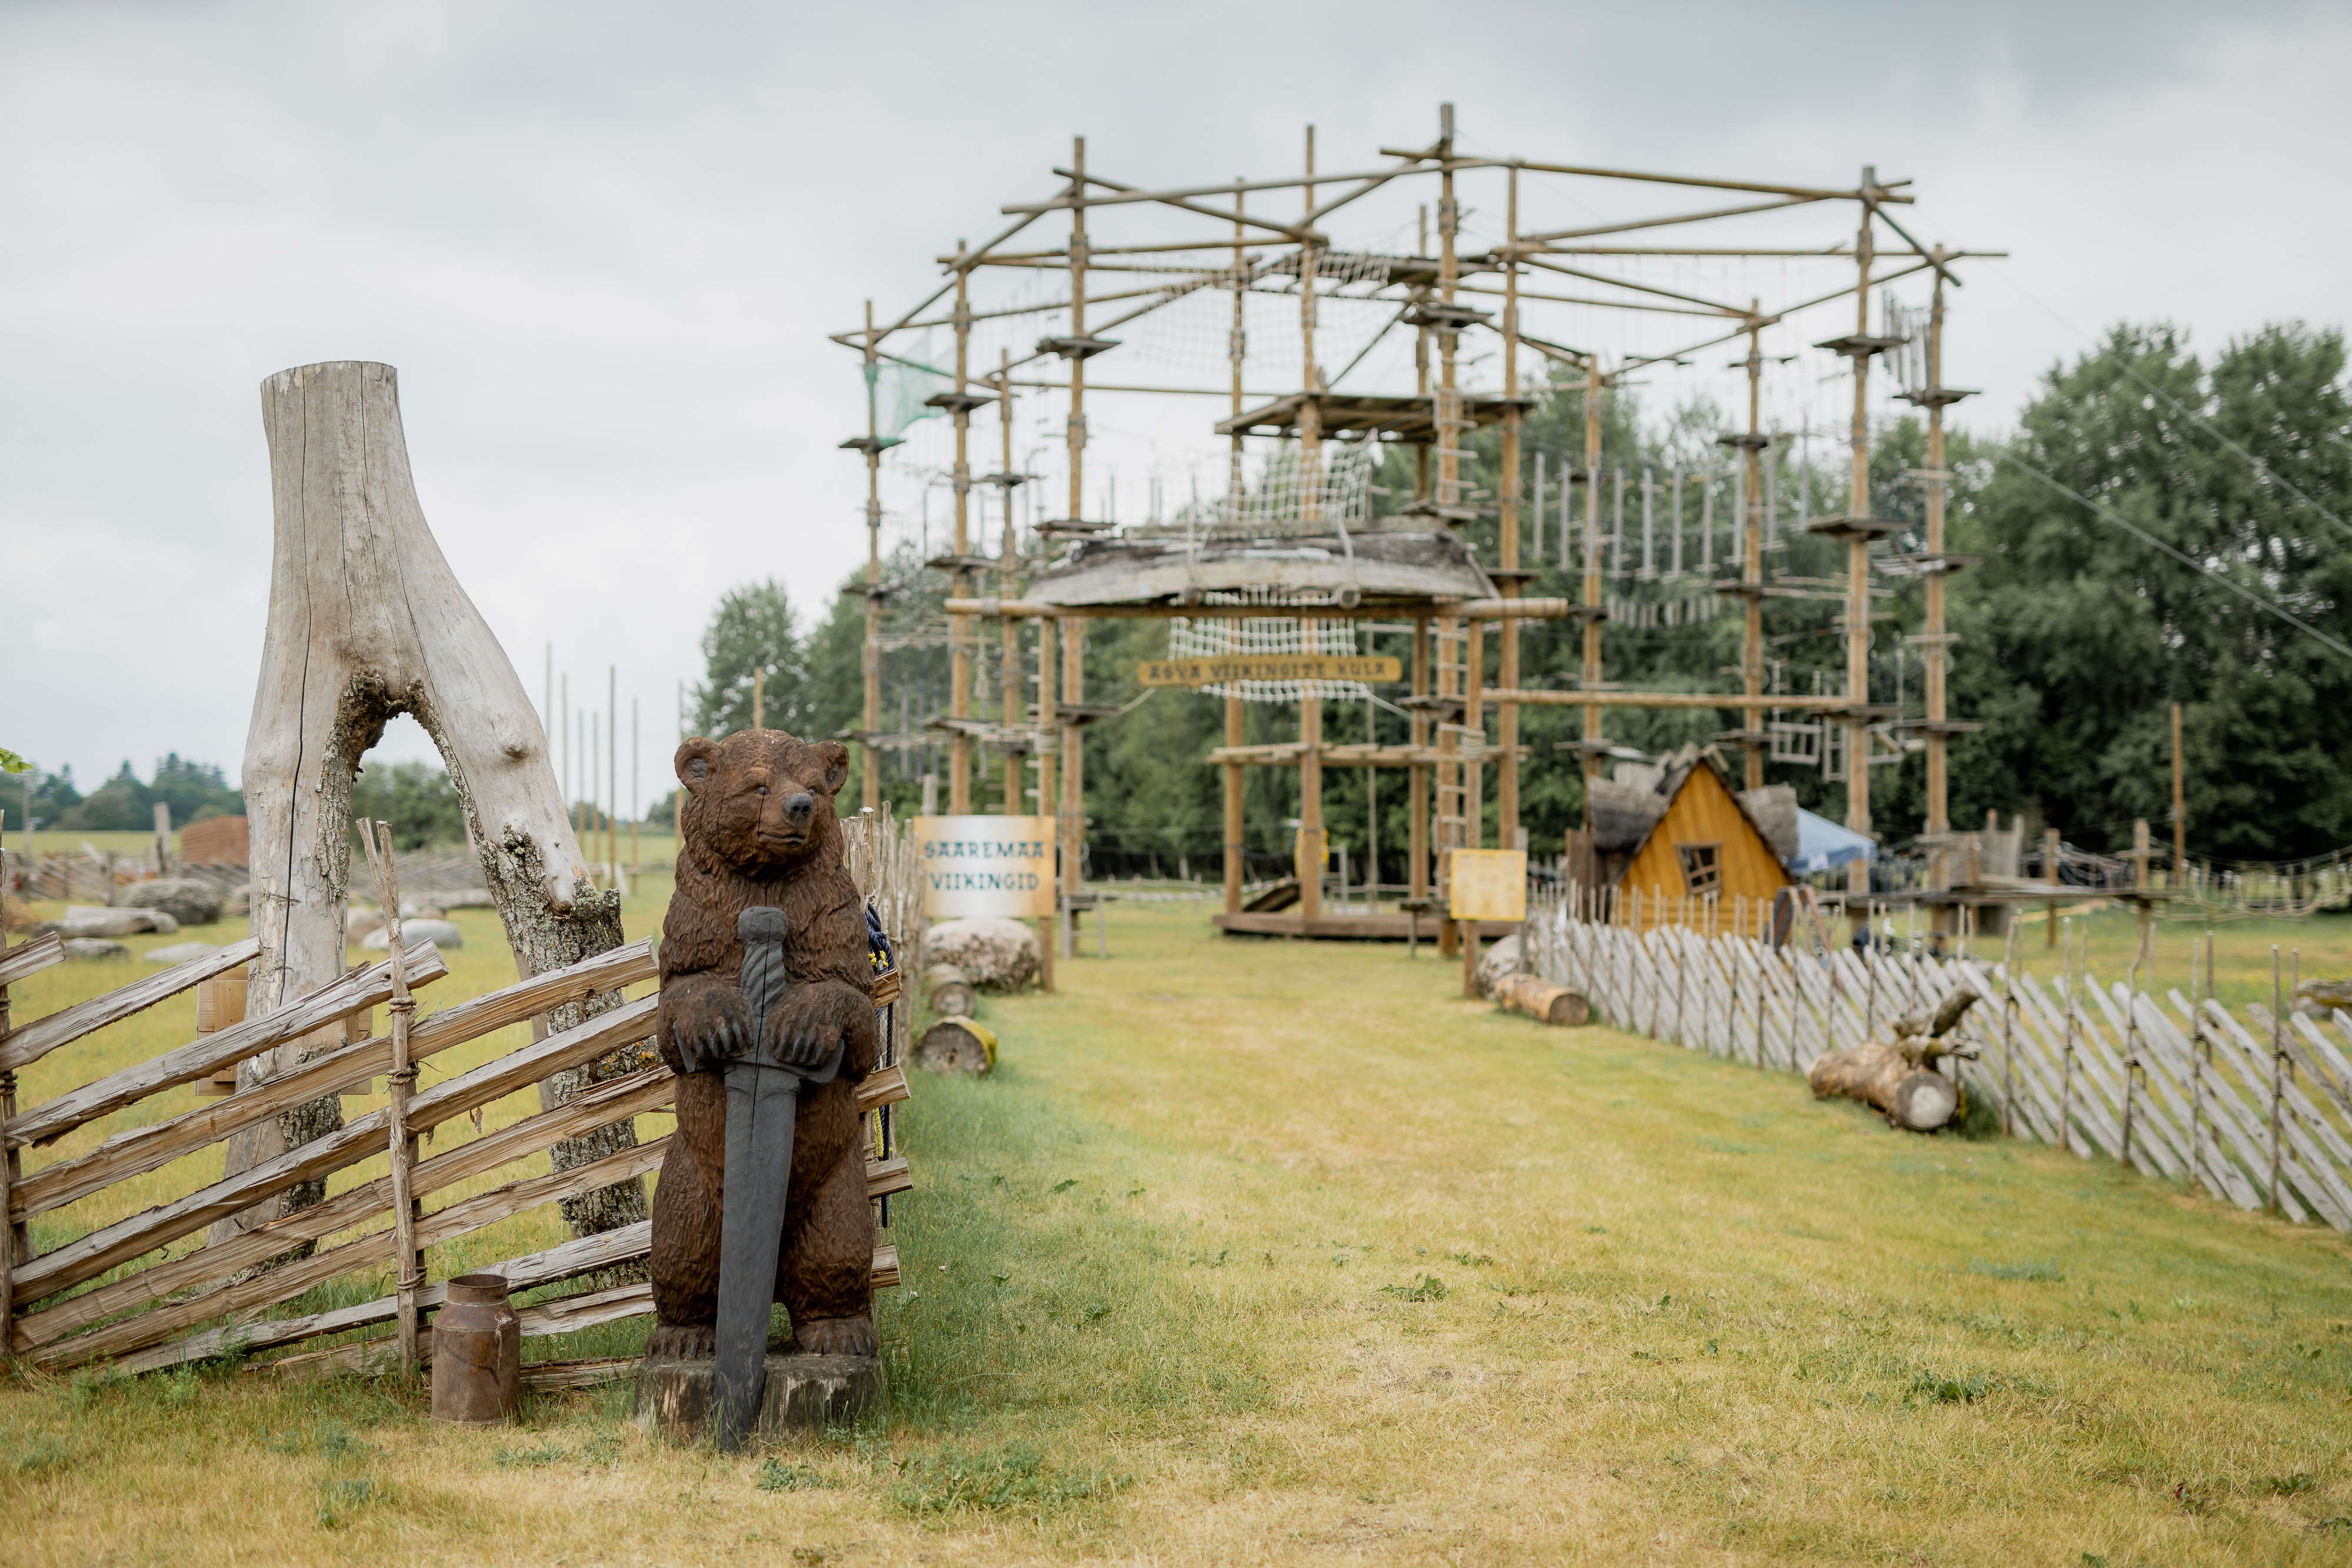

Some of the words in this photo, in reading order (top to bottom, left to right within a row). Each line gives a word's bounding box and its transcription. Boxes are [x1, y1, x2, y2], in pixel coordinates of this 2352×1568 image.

[1210, 662, 1325, 678] VIIKINGITE
[924, 841, 1044, 858] SAAREMAA
[929, 872, 1040, 890] VIIKINGID
